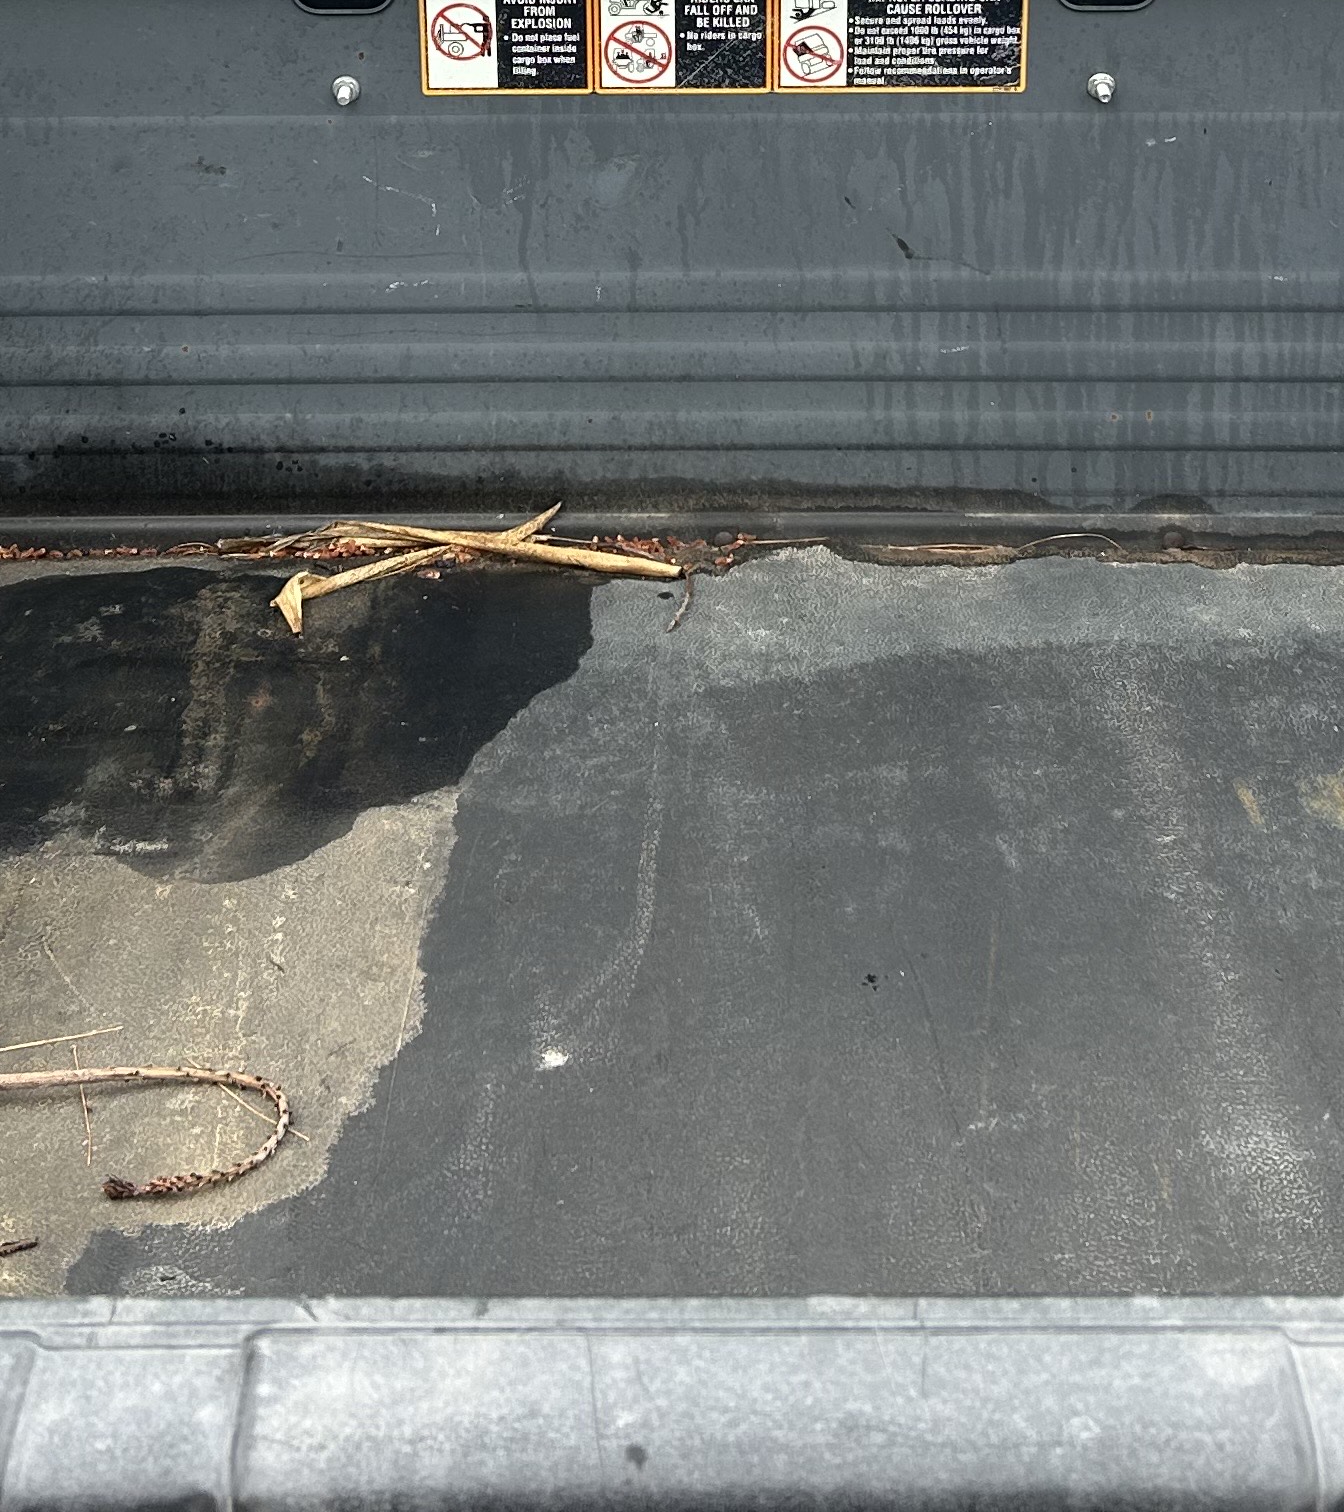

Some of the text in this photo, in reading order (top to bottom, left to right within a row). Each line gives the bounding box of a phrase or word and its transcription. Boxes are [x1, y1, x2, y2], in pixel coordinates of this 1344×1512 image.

[523, 6, 556, 17] FROM
[684, 4, 758, 16] FALL OFF AND
[886, 3, 982, 15] CAUSE ROLLOVER
[511, 18, 572, 29] EXPLOSION
[696, 17, 750, 28] BE KILLED
[701, 31, 726, 40] riders
